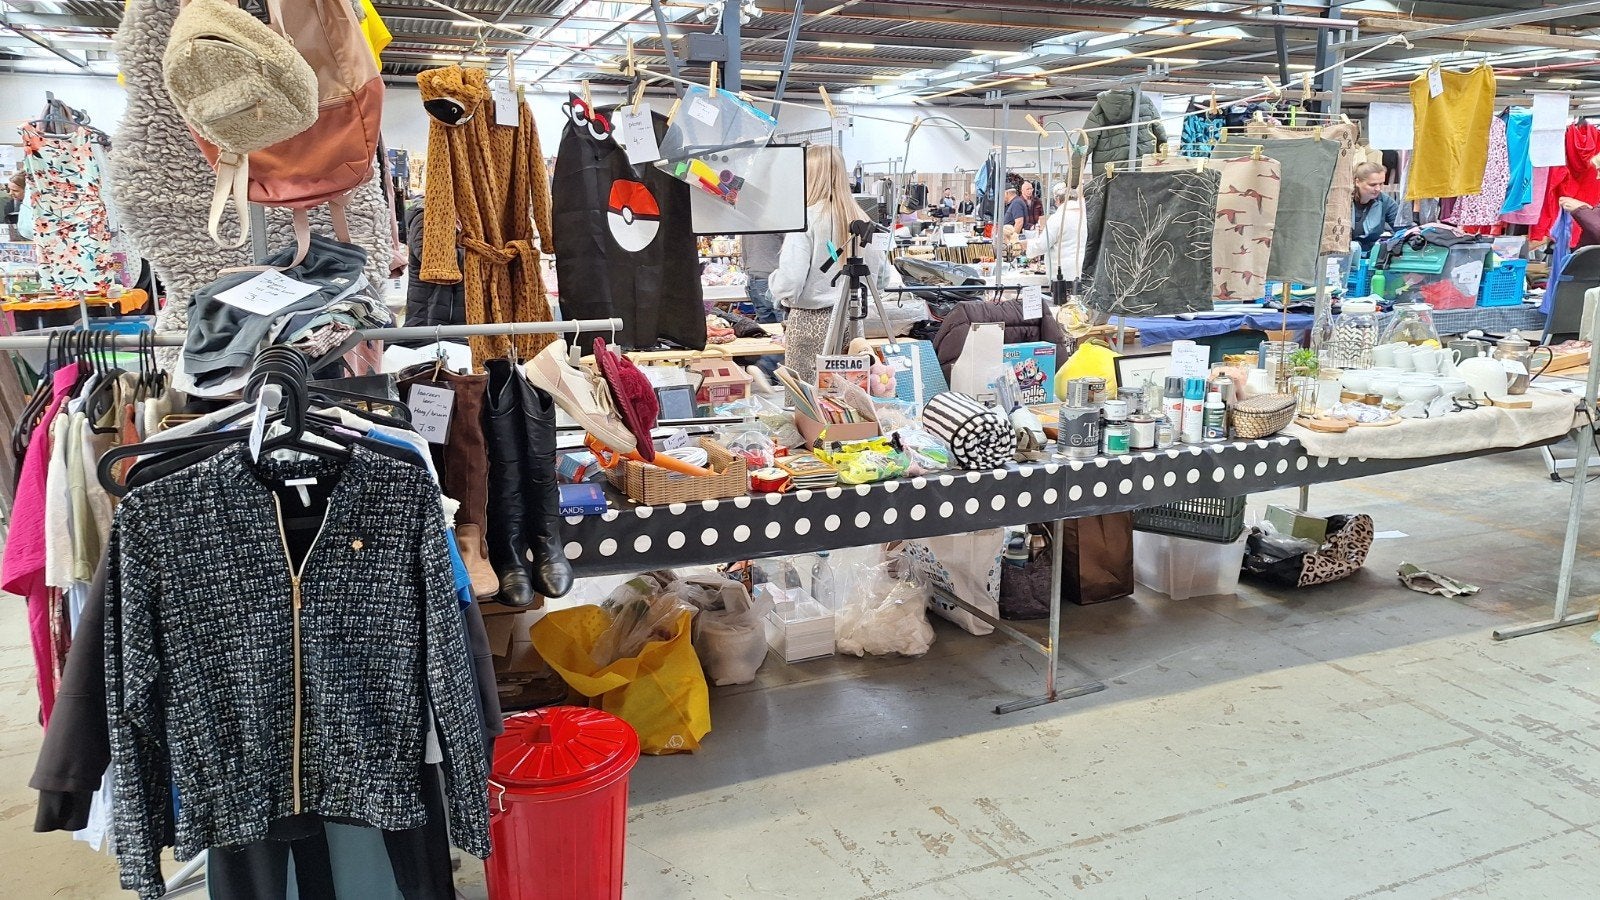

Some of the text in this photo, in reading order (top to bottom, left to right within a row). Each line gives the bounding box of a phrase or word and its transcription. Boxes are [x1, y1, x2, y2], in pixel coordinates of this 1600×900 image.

[825, 359, 862, 370] ZEESLAG
[1021, 384, 1045, 398] milie
[1023, 393, 1047, 405] dspel
